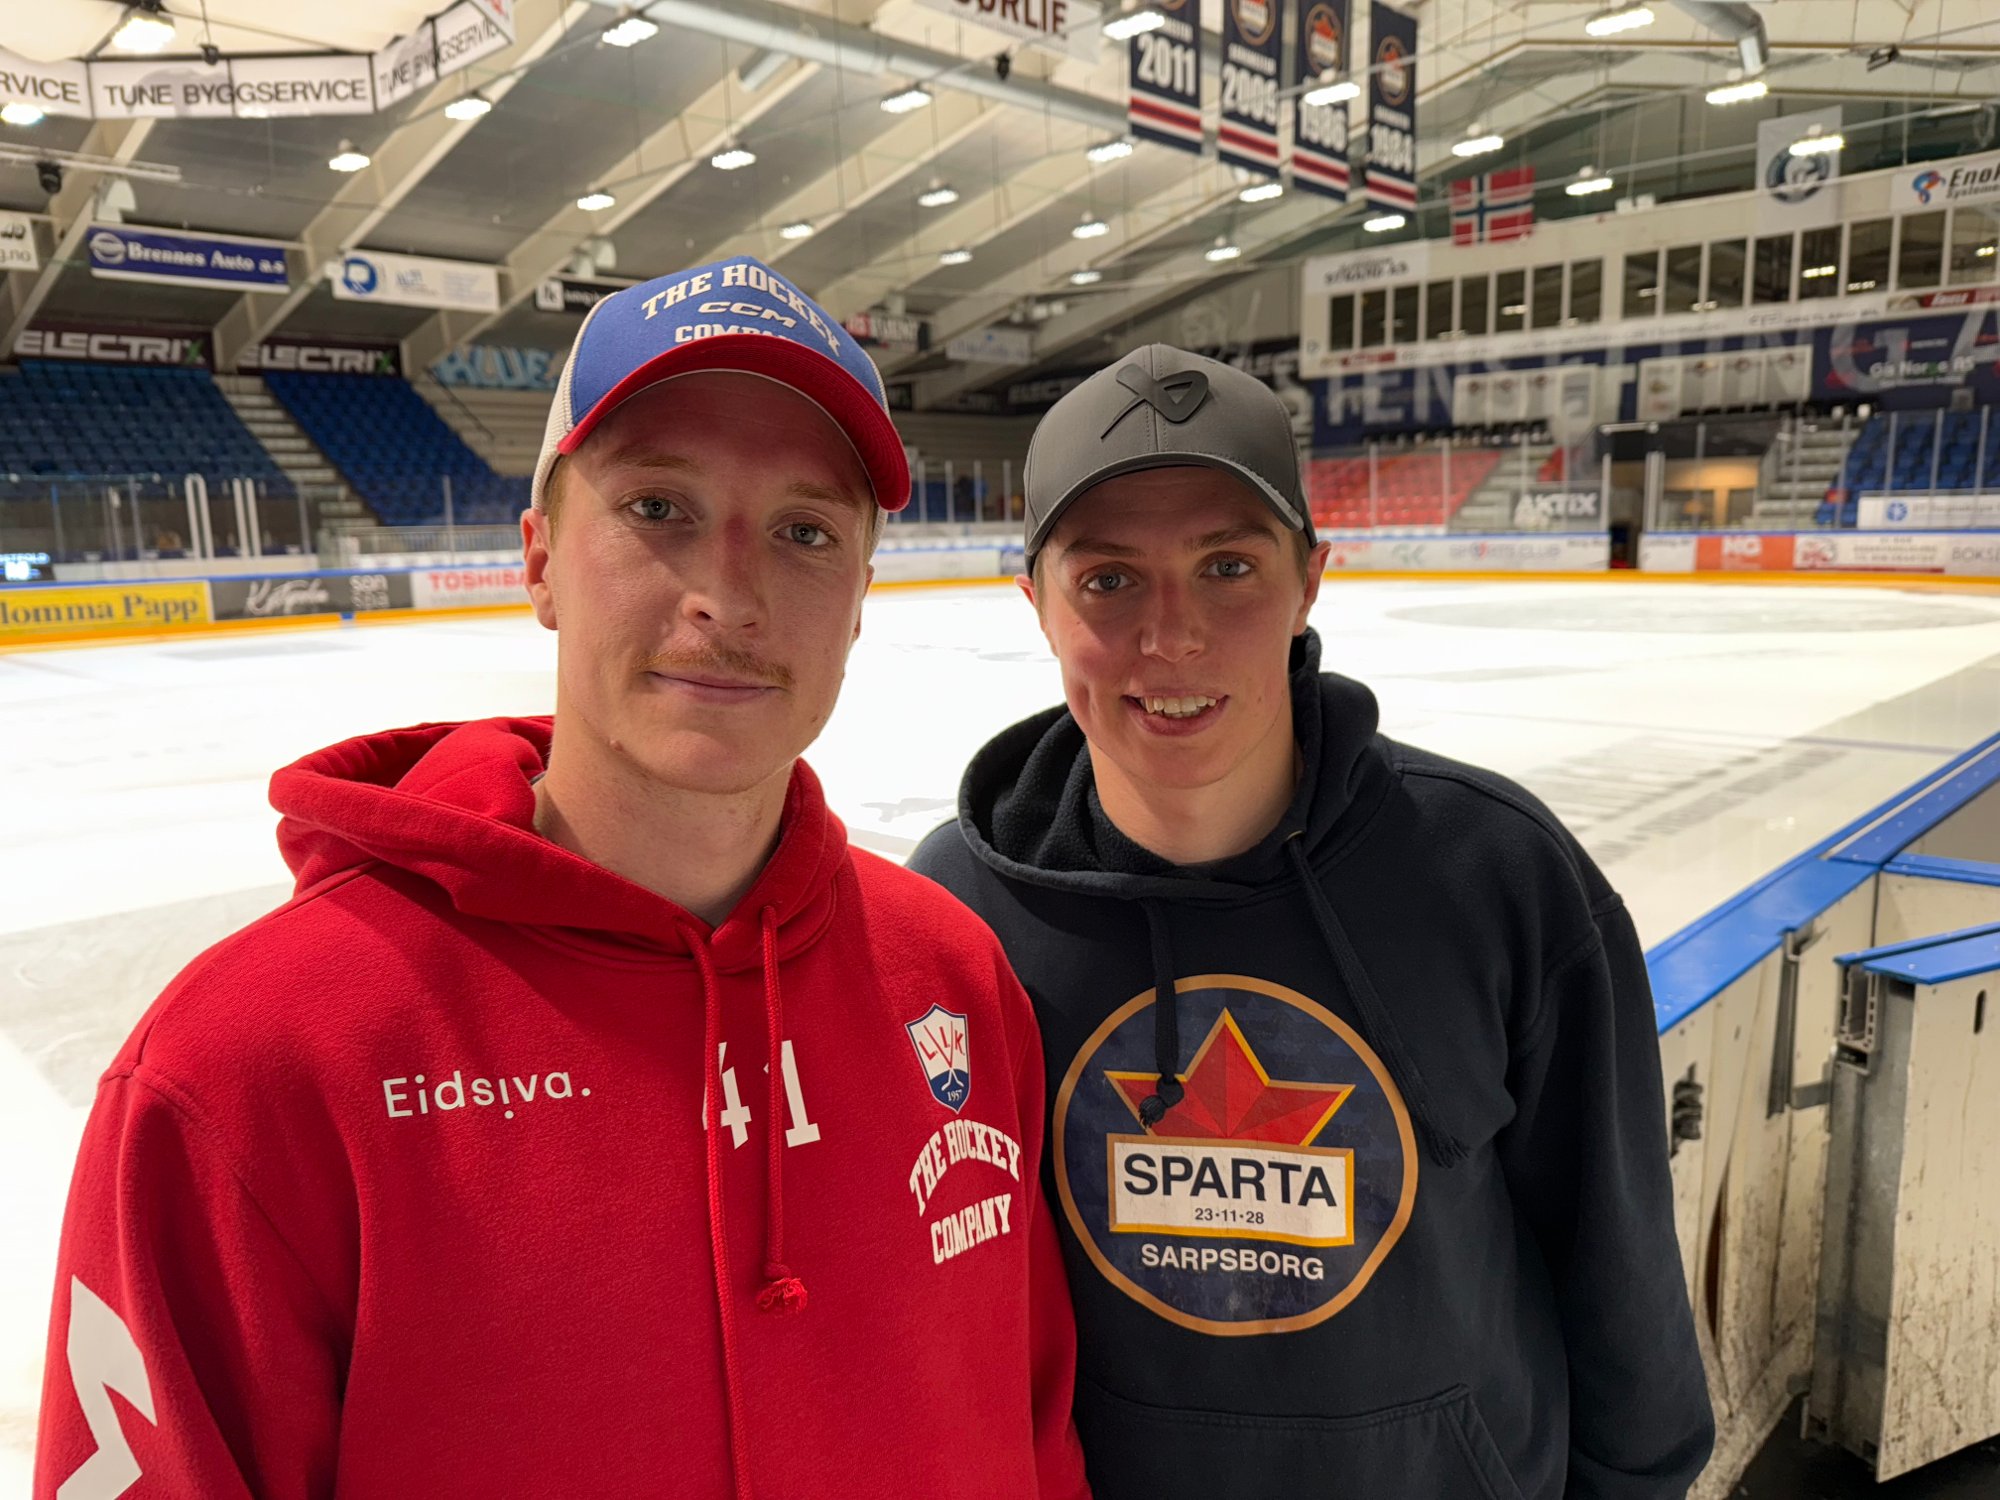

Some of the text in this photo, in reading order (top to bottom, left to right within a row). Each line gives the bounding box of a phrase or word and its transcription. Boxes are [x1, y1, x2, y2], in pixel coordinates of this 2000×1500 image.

[1137, 31, 1197, 97] 2011
[103, 78, 367, 107] TUNE BYGGSERVICE
[128, 240, 206, 268] Brennes
[210, 249, 255, 272] Auto
[641, 263, 841, 357] THE HOCKEY
[698, 301, 797, 328] CCM
[14, 329, 207, 365] ELECTRIX
[122, 592, 199, 624] Papp
[702, 1039, 821, 1150] 41
[947, 1088, 963, 1102] 1957
[909, 1118, 1020, 1218] THE HOCKEY
[1123, 1152, 1338, 1208] SPARTA
[930, 1193, 1012, 1265] COMPANY
[1140, 1243, 1325, 1280] SARPSBORG
